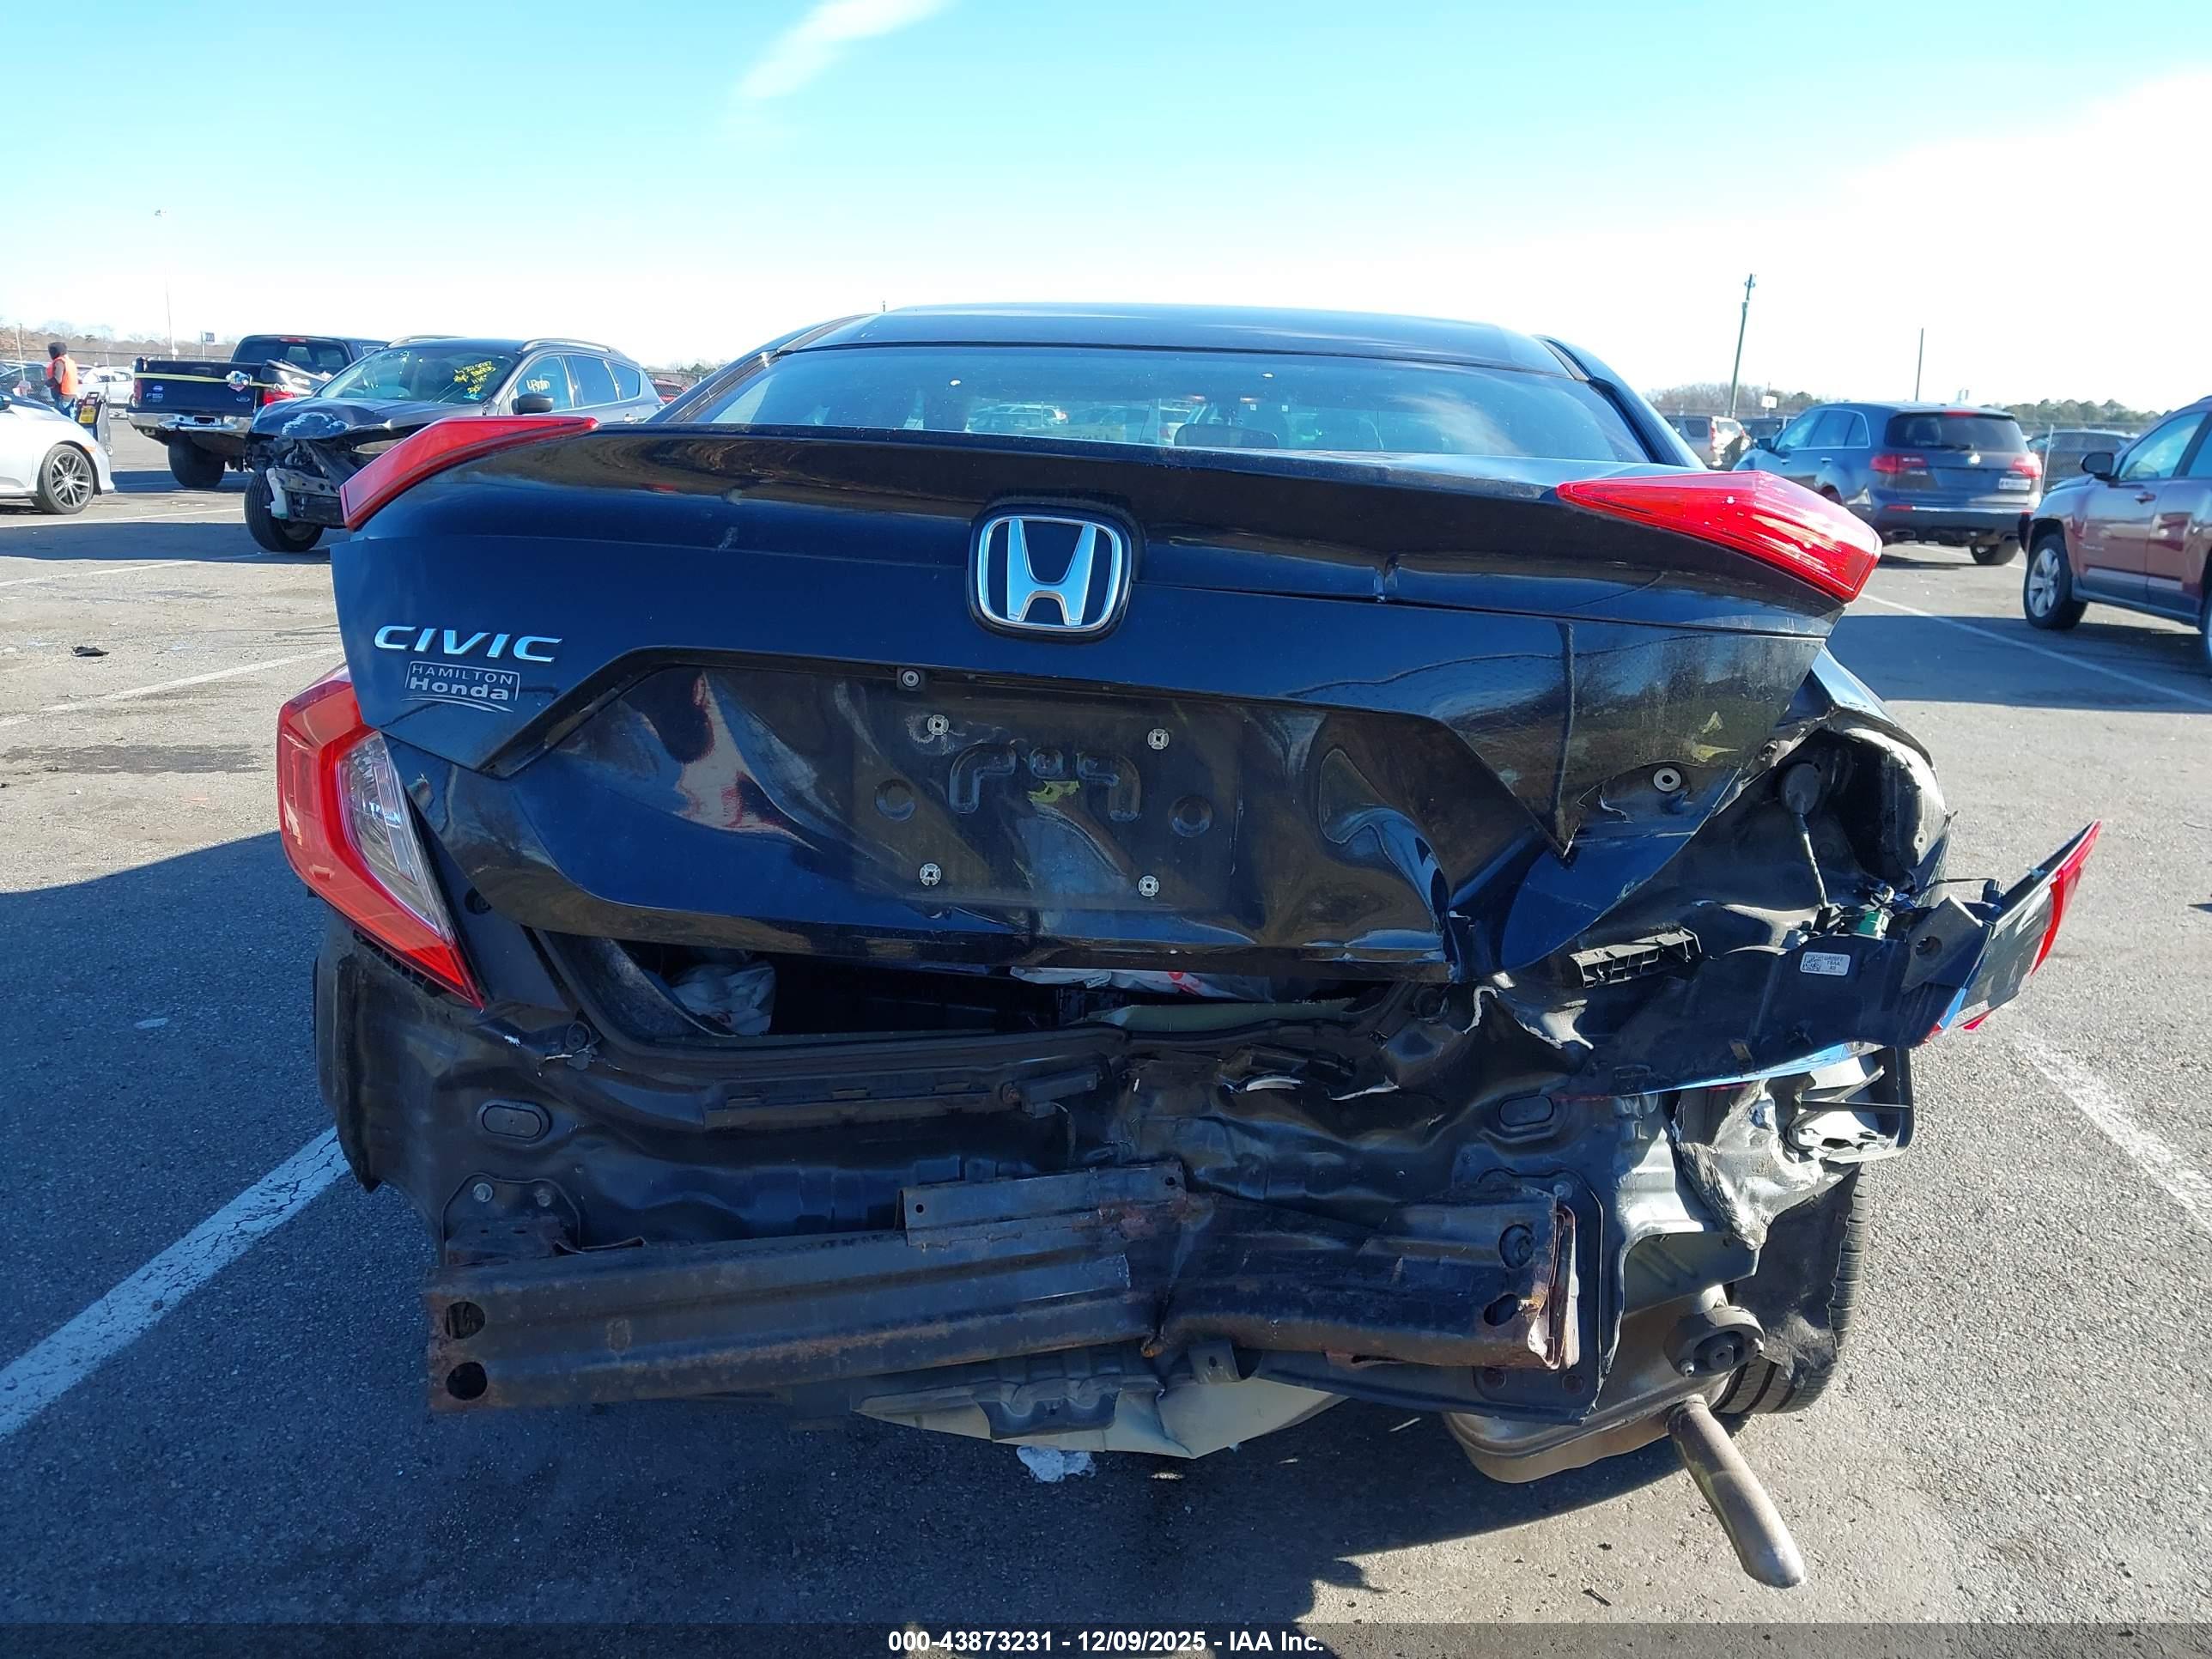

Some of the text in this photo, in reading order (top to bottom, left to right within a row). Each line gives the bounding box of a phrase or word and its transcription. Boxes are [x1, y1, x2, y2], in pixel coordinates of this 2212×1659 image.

[374, 625, 562, 663] CIVIC
[412, 664, 514, 685] HAMILTON
[409, 677, 509, 701] Honda
